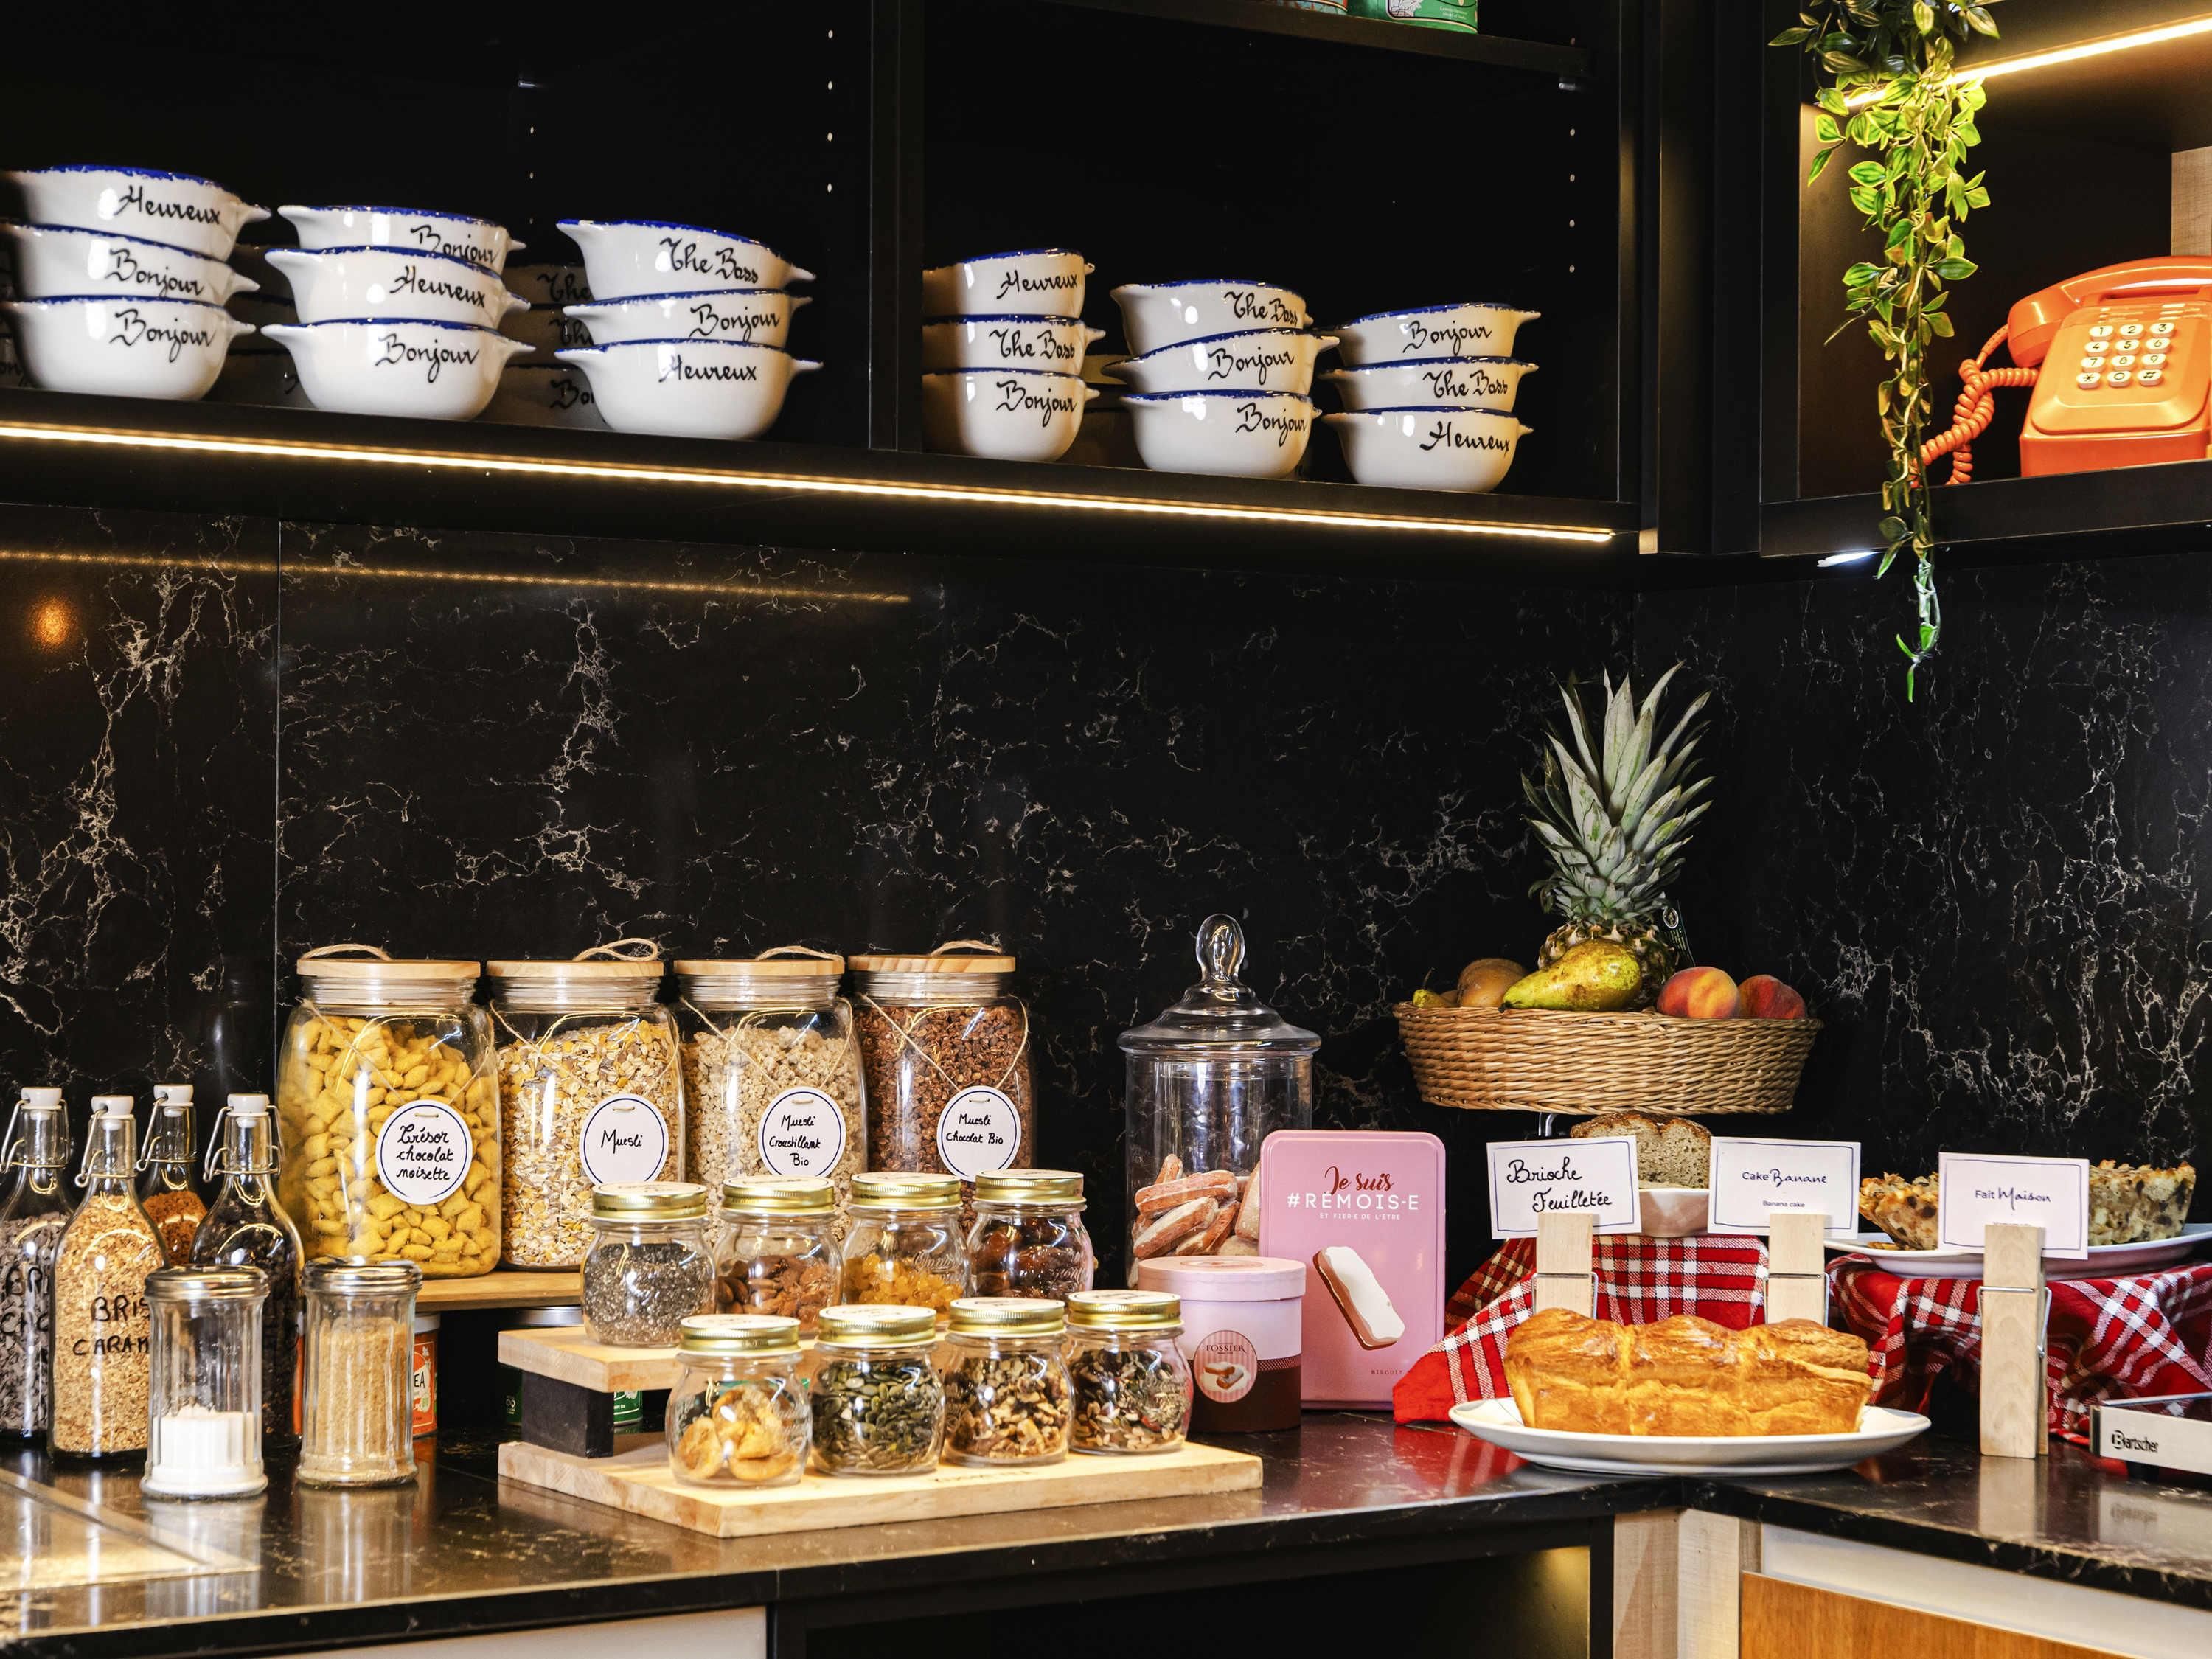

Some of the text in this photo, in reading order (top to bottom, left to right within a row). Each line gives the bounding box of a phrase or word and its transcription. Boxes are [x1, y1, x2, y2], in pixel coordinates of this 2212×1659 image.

[115, 185, 220, 225] Heureux
[410, 224, 499, 263] Bonjour
[660, 237, 713, 274] The
[105, 248, 205, 296] Bonjour
[996, 270, 1078, 299] Heureux
[390, 266, 486, 309] Heureux
[1224, 291, 1268, 319] The
[109, 307, 216, 362] Bonjour
[689, 304, 781, 341] Bonjour
[2127, 325, 2136, 334] 2
[2158, 324, 2167, 332] 3
[989, 328, 1035, 358] The
[1402, 320, 1492, 356] Bonjour
[2123, 341, 2132, 349] 5
[2154, 339, 2163, 347] 6
[375, 333, 481, 383] Bonjour
[658, 355, 757, 383] Heureux
[1208, 347, 1295, 386] Bonjour
[1422, 369, 1469, 398] The
[995, 380, 1077, 428] Bonjour
[1235, 402, 1307, 447] Bonjour
[1420, 420, 1512, 456] Heureux
[781, 1114, 816, 1131] Muesli
[959, 1113, 992, 1126] Muesli
[397, 1124, 449, 1144] Trésor
[601, 1129, 643, 1155] Muesli
[768, 1135, 821, 1149] Croustillant
[946, 1130, 1004, 1144] Chocolat Bio
[396, 1145, 454, 1162] chocolat
[789, 1152, 810, 1166] Bio
[396, 1166, 451, 1180] noisette
[1324, 1166, 1395, 1195] Je suis
[1506, 1156, 1583, 1183] Brioche
[1742, 1168, 1827, 1187] Cake Banane
[1532, 1187, 1613, 1213] Feuilletée
[1975, 1186, 2052, 1211] Fait Maison
[91, 1295, 150, 1321] BRIS
[72, 1335, 150, 1355] CARAM
[1206, 1344, 1247, 1354] FOSSIER
[2111, 1430, 2159, 1453] Bartscher
